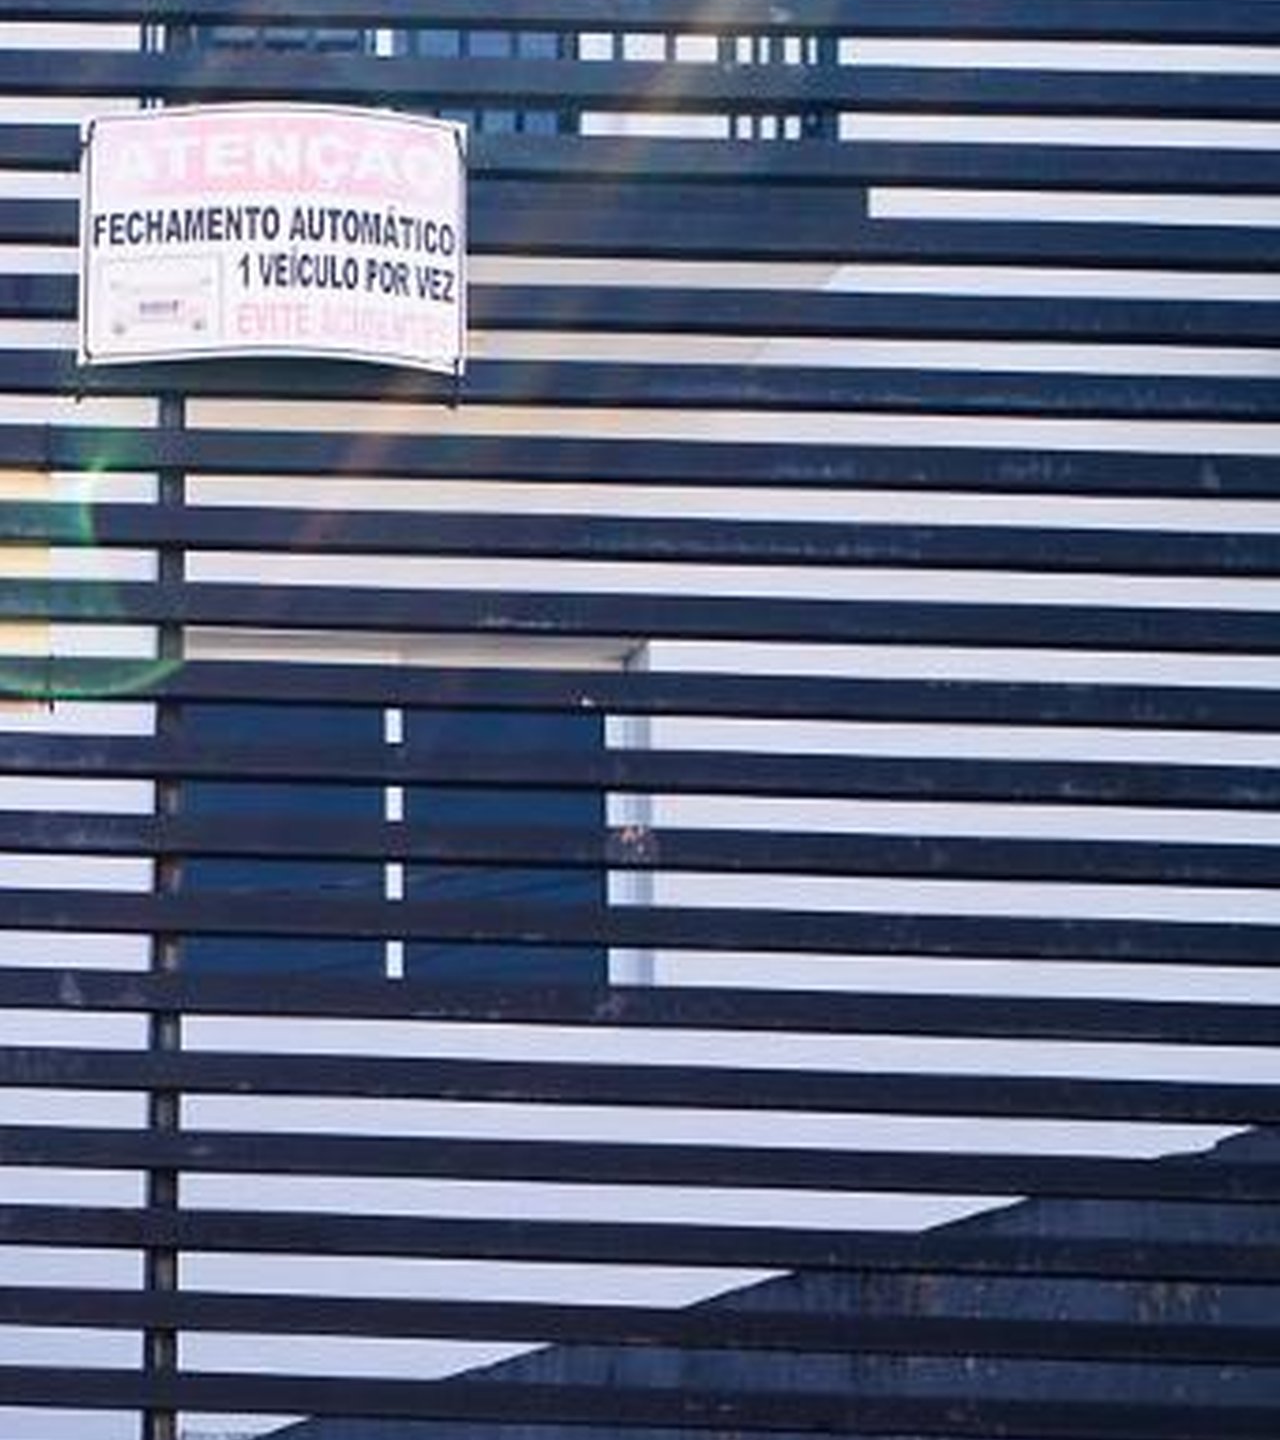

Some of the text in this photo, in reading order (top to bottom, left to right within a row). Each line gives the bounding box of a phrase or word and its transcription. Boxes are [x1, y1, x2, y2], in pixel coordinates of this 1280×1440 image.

[93, 205, 456, 256] FECHAMENTO AUTOMÁTICO
[239, 244, 455, 304] 1 VEÍCULO POR VEZ
